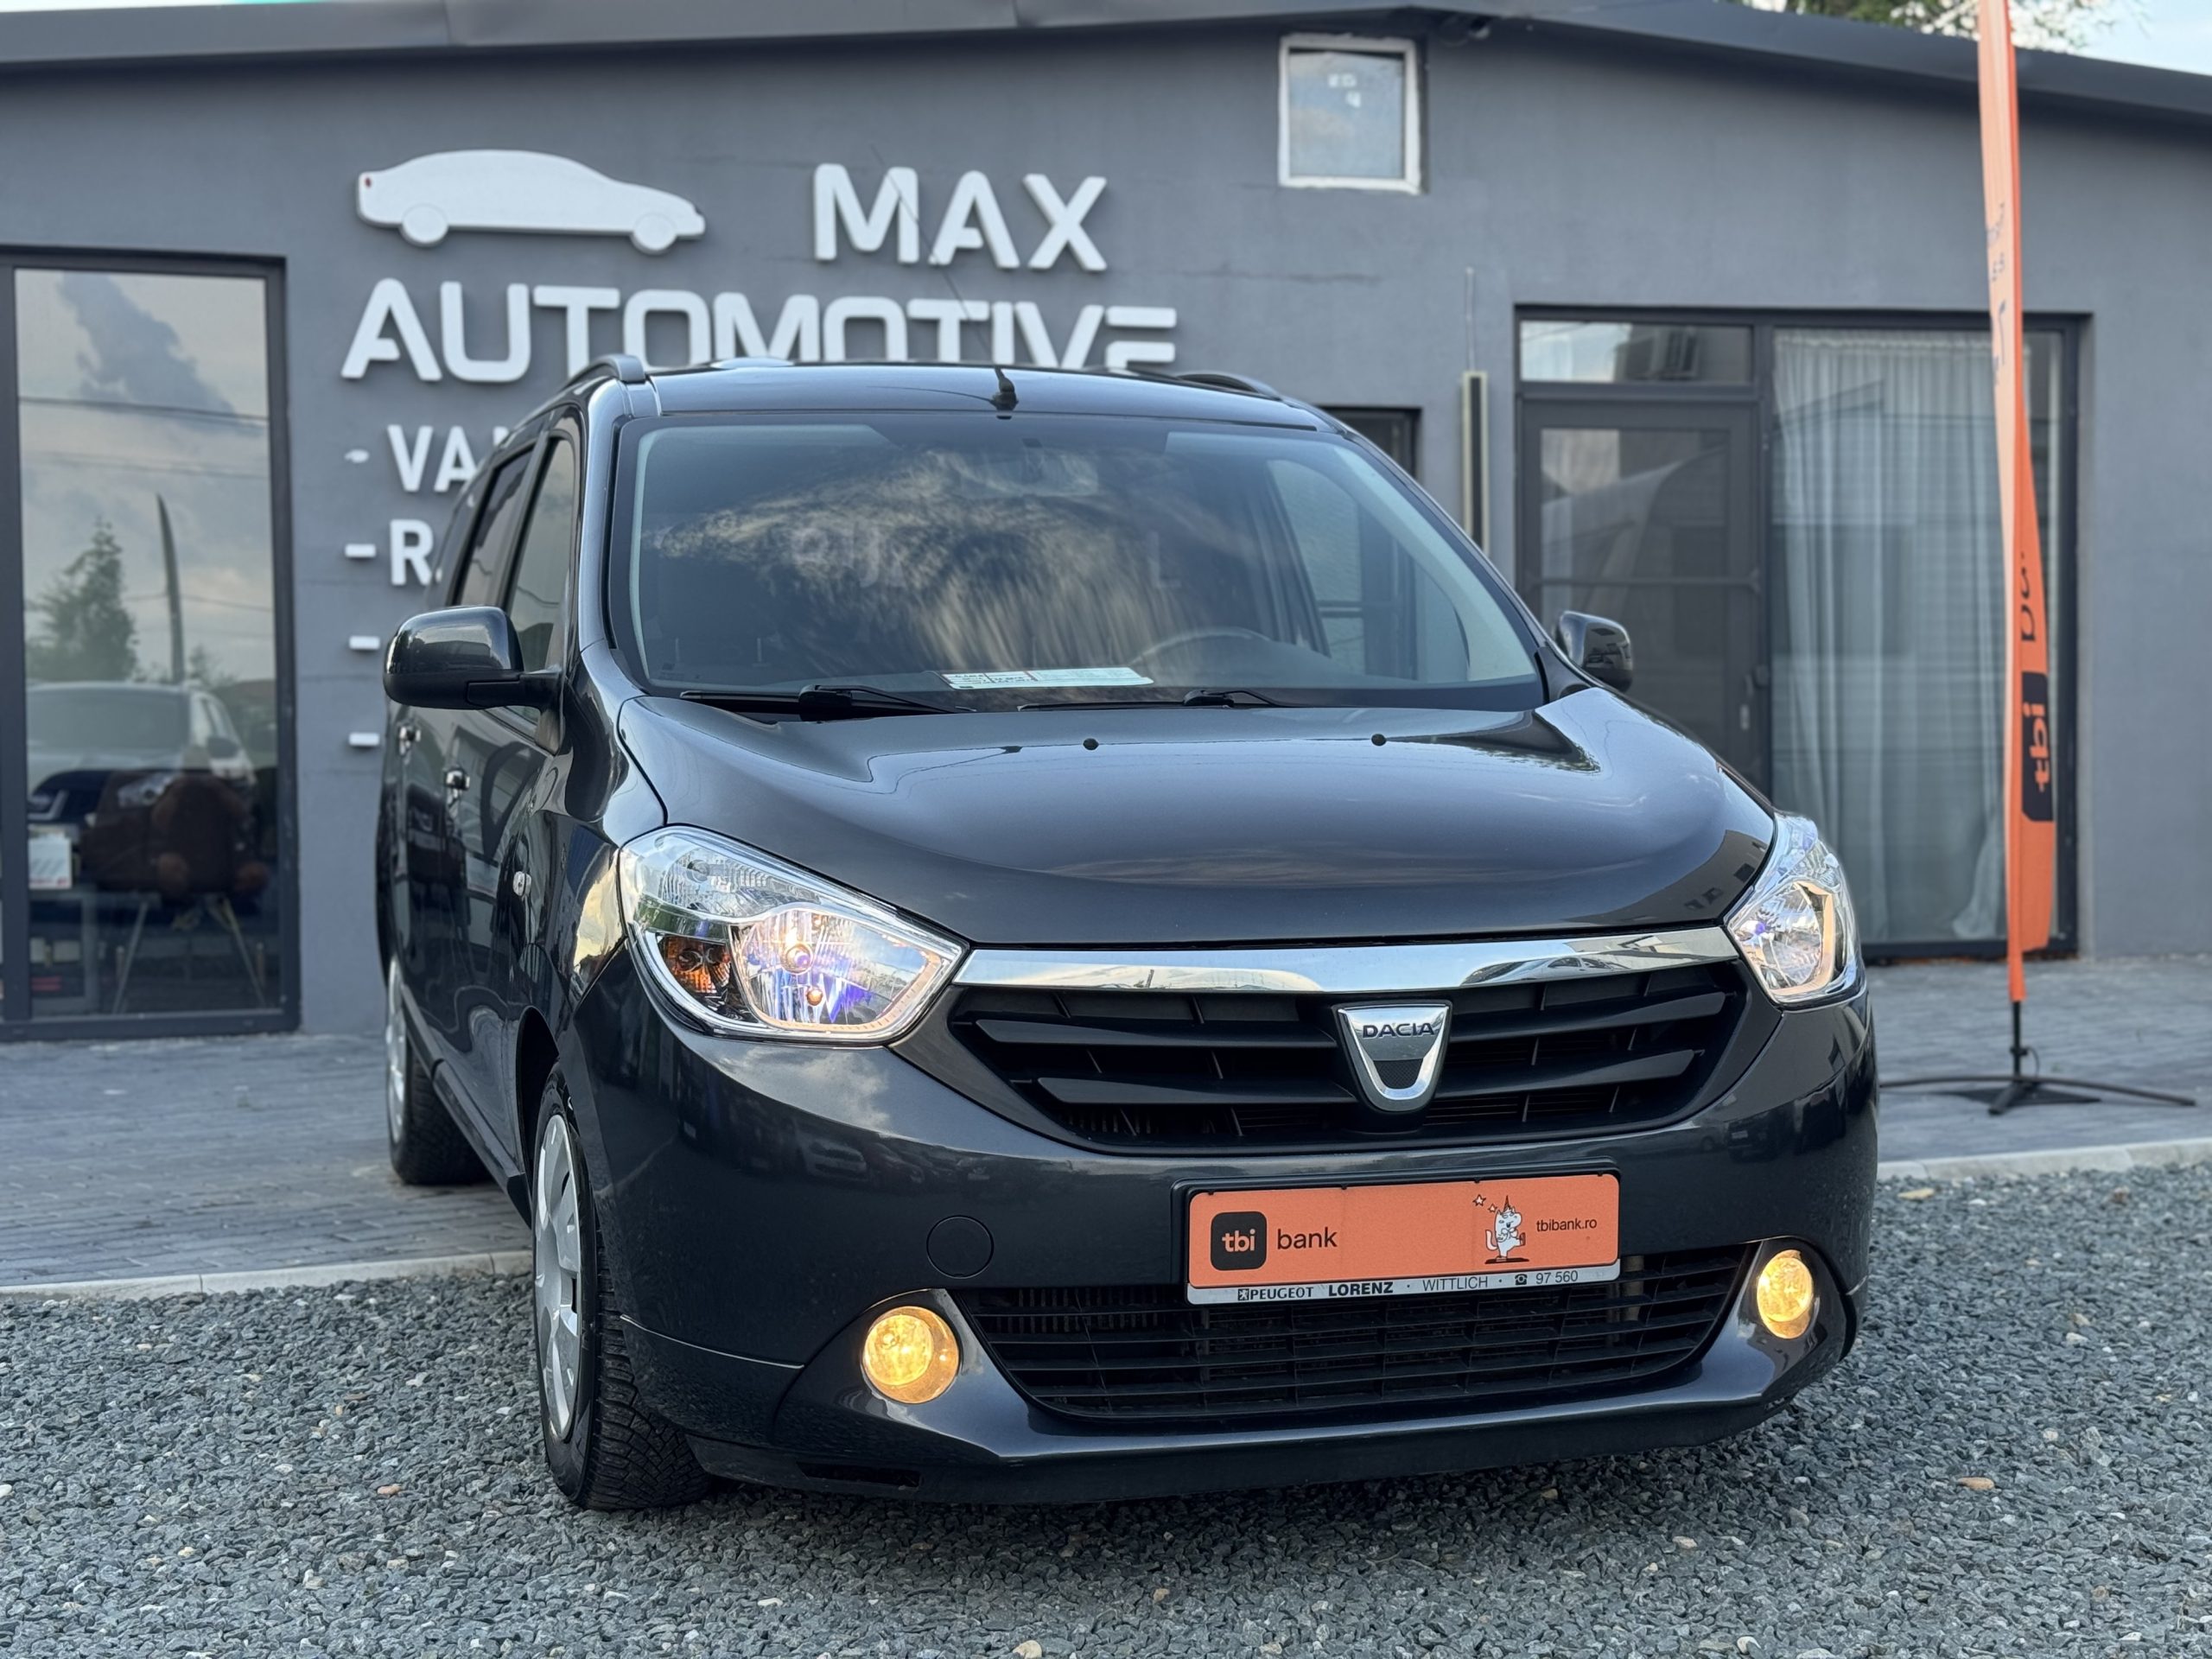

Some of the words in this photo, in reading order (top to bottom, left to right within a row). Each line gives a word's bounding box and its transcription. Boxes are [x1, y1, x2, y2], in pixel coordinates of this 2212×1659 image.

[814, 163, 1108, 271] MAX
[340, 278, 1177, 383] AUTOMOTIVE
[387, 424, 510, 493] VA
[1363, 1022, 1434, 1038] DACIA
[1222, 1229, 1256, 1252] tbi
[1278, 1227, 1338, 1250] bank
[1535, 1217, 1598, 1233] tbibank.ro
[1250, 1287, 1314, 1300] PEUGEOT
[1328, 1281, 1394, 1297] LORENZ
[1422, 1276, 1488, 1292] WITTLICH
[1535, 1273, 1552, 1285] 97
[1555, 1270, 1579, 1283] 560
